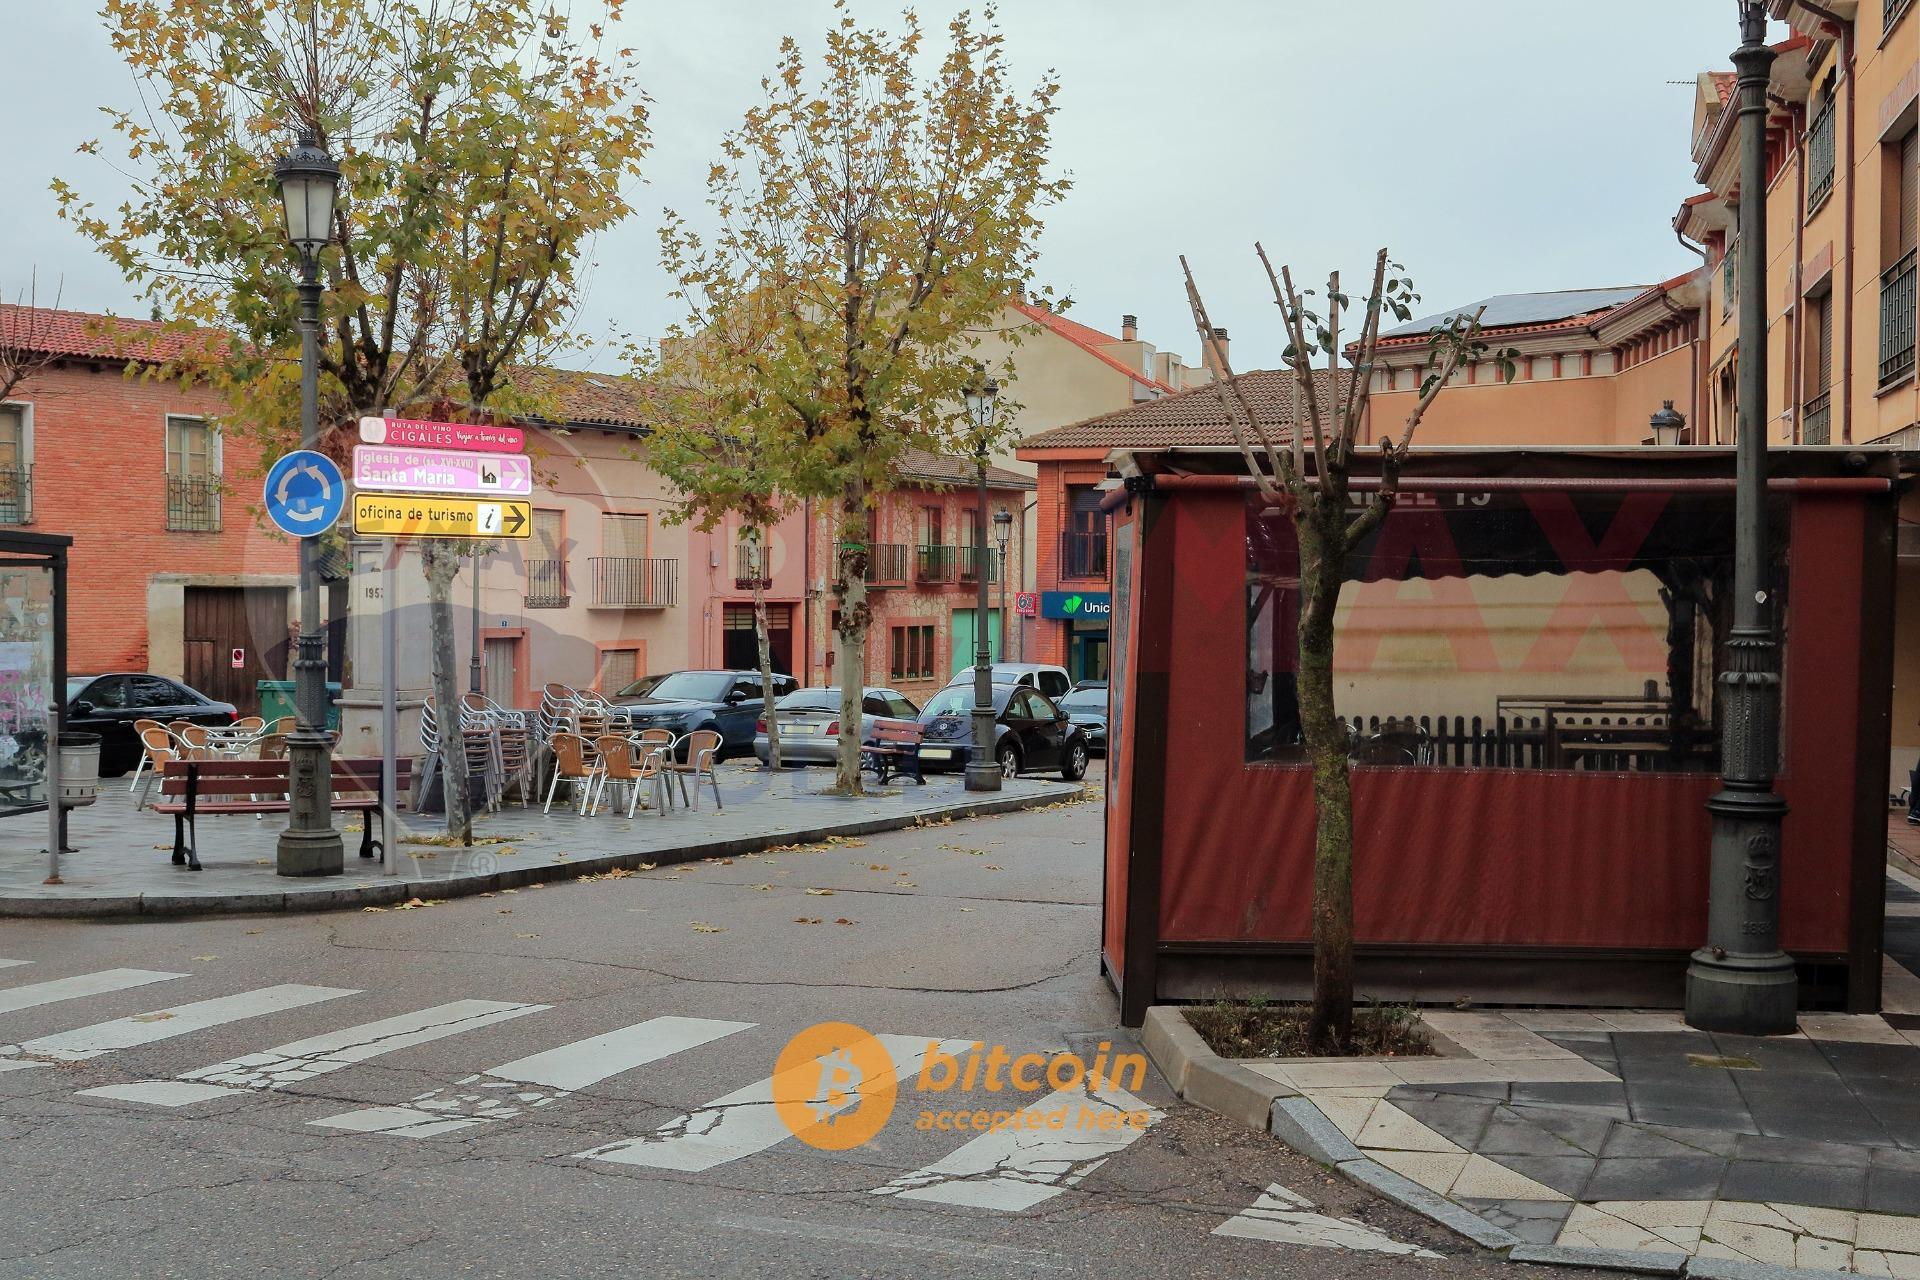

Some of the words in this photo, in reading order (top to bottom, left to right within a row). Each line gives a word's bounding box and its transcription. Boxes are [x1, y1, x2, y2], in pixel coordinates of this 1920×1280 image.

[391, 421, 412, 429] RUTA
[415, 423, 429, 431] DEL
[390, 430, 452, 444] CIGALES
[405, 454, 420, 465] de
[361, 465, 407, 483] Santa
[414, 468, 456, 486] María
[359, 505, 402, 519] oficina
[408, 508, 423, 520] de
[428, 508, 474, 521] turismo
[1084, 602, 1110, 613] Unic
